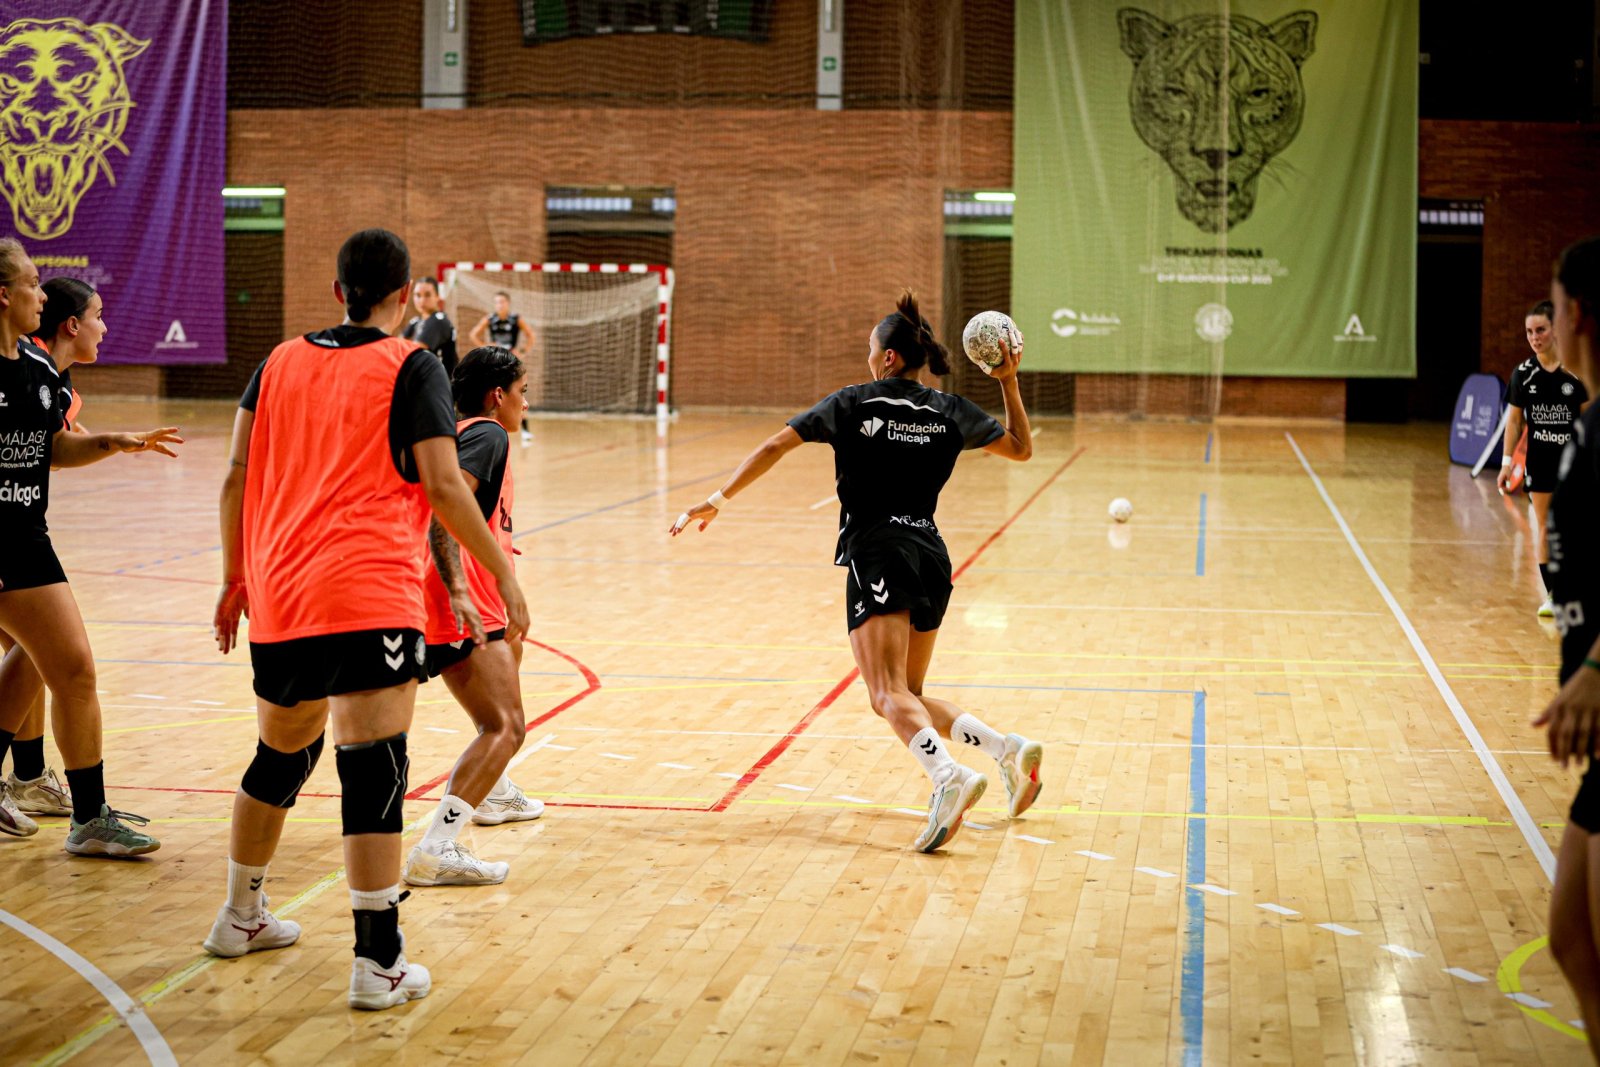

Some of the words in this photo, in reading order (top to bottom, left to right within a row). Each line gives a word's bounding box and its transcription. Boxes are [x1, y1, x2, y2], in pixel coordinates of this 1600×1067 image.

[1532, 403, 1569, 413] MÁLAGA
[1531, 412, 1573, 421] COMPITE
[887, 419, 947, 434] Fundación
[887, 430, 931, 445] Unicaja
